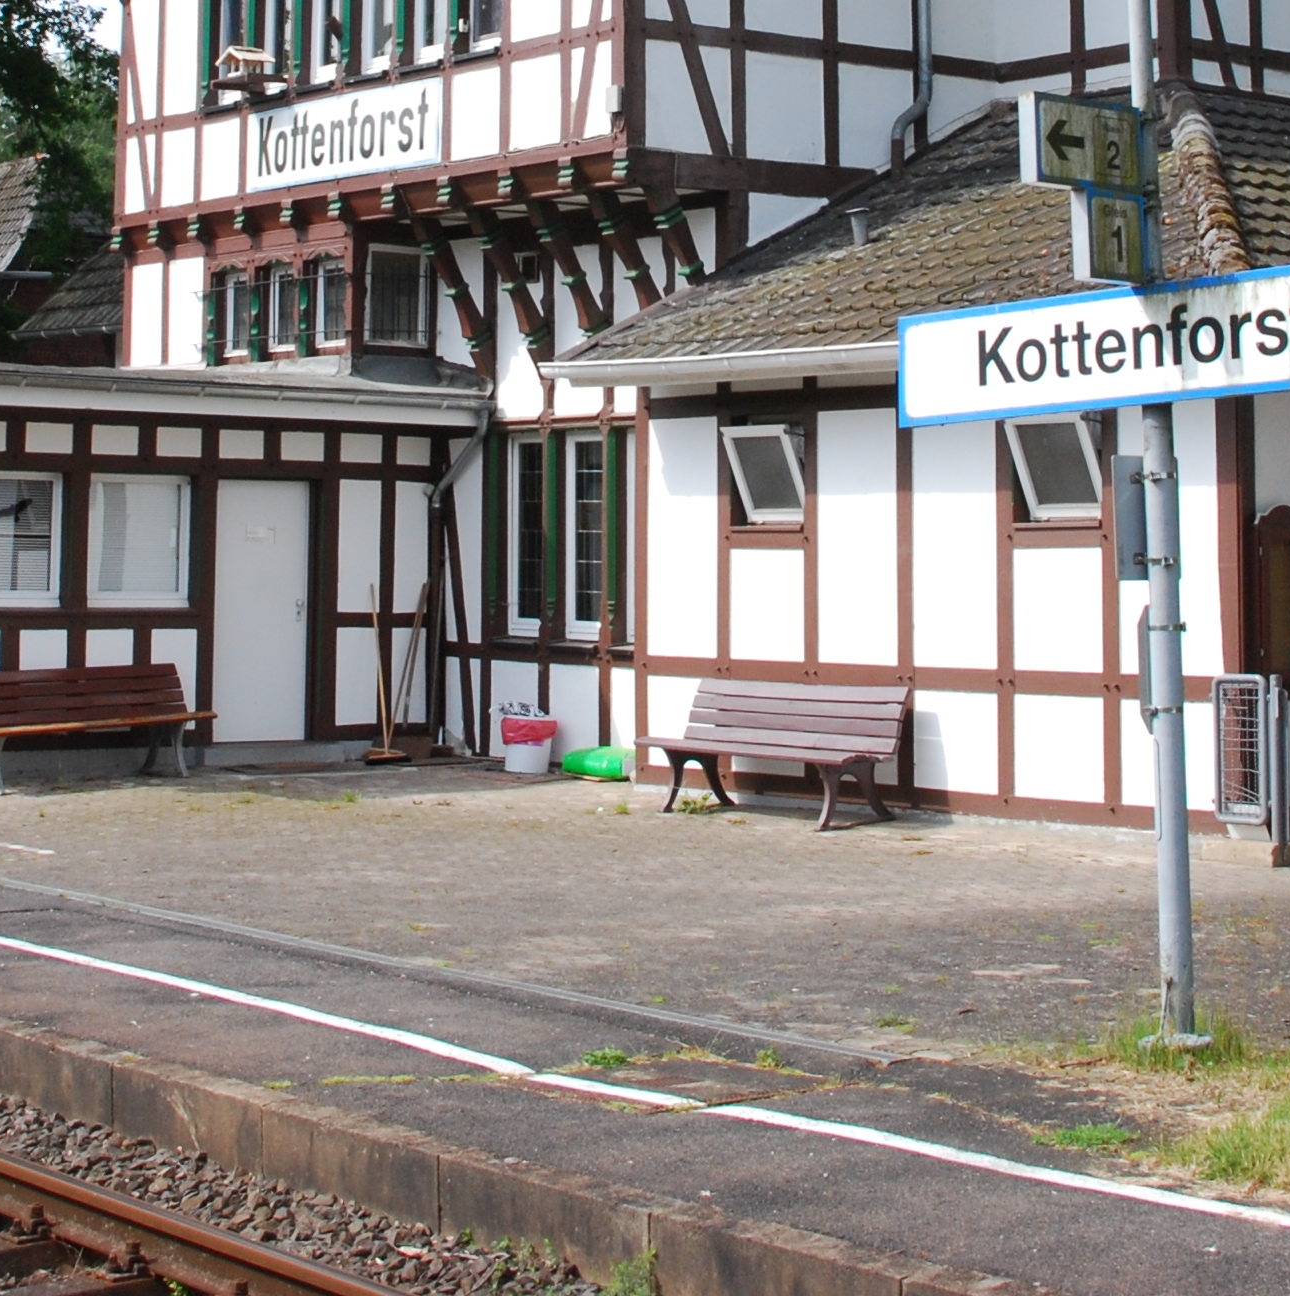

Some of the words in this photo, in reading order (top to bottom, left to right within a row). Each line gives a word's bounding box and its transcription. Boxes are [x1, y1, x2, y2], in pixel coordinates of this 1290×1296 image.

[258, 89, 429, 177] Kottenforst
[1107, 141, 1121, 170] 2
[1111, 226, 1123, 263] 1
